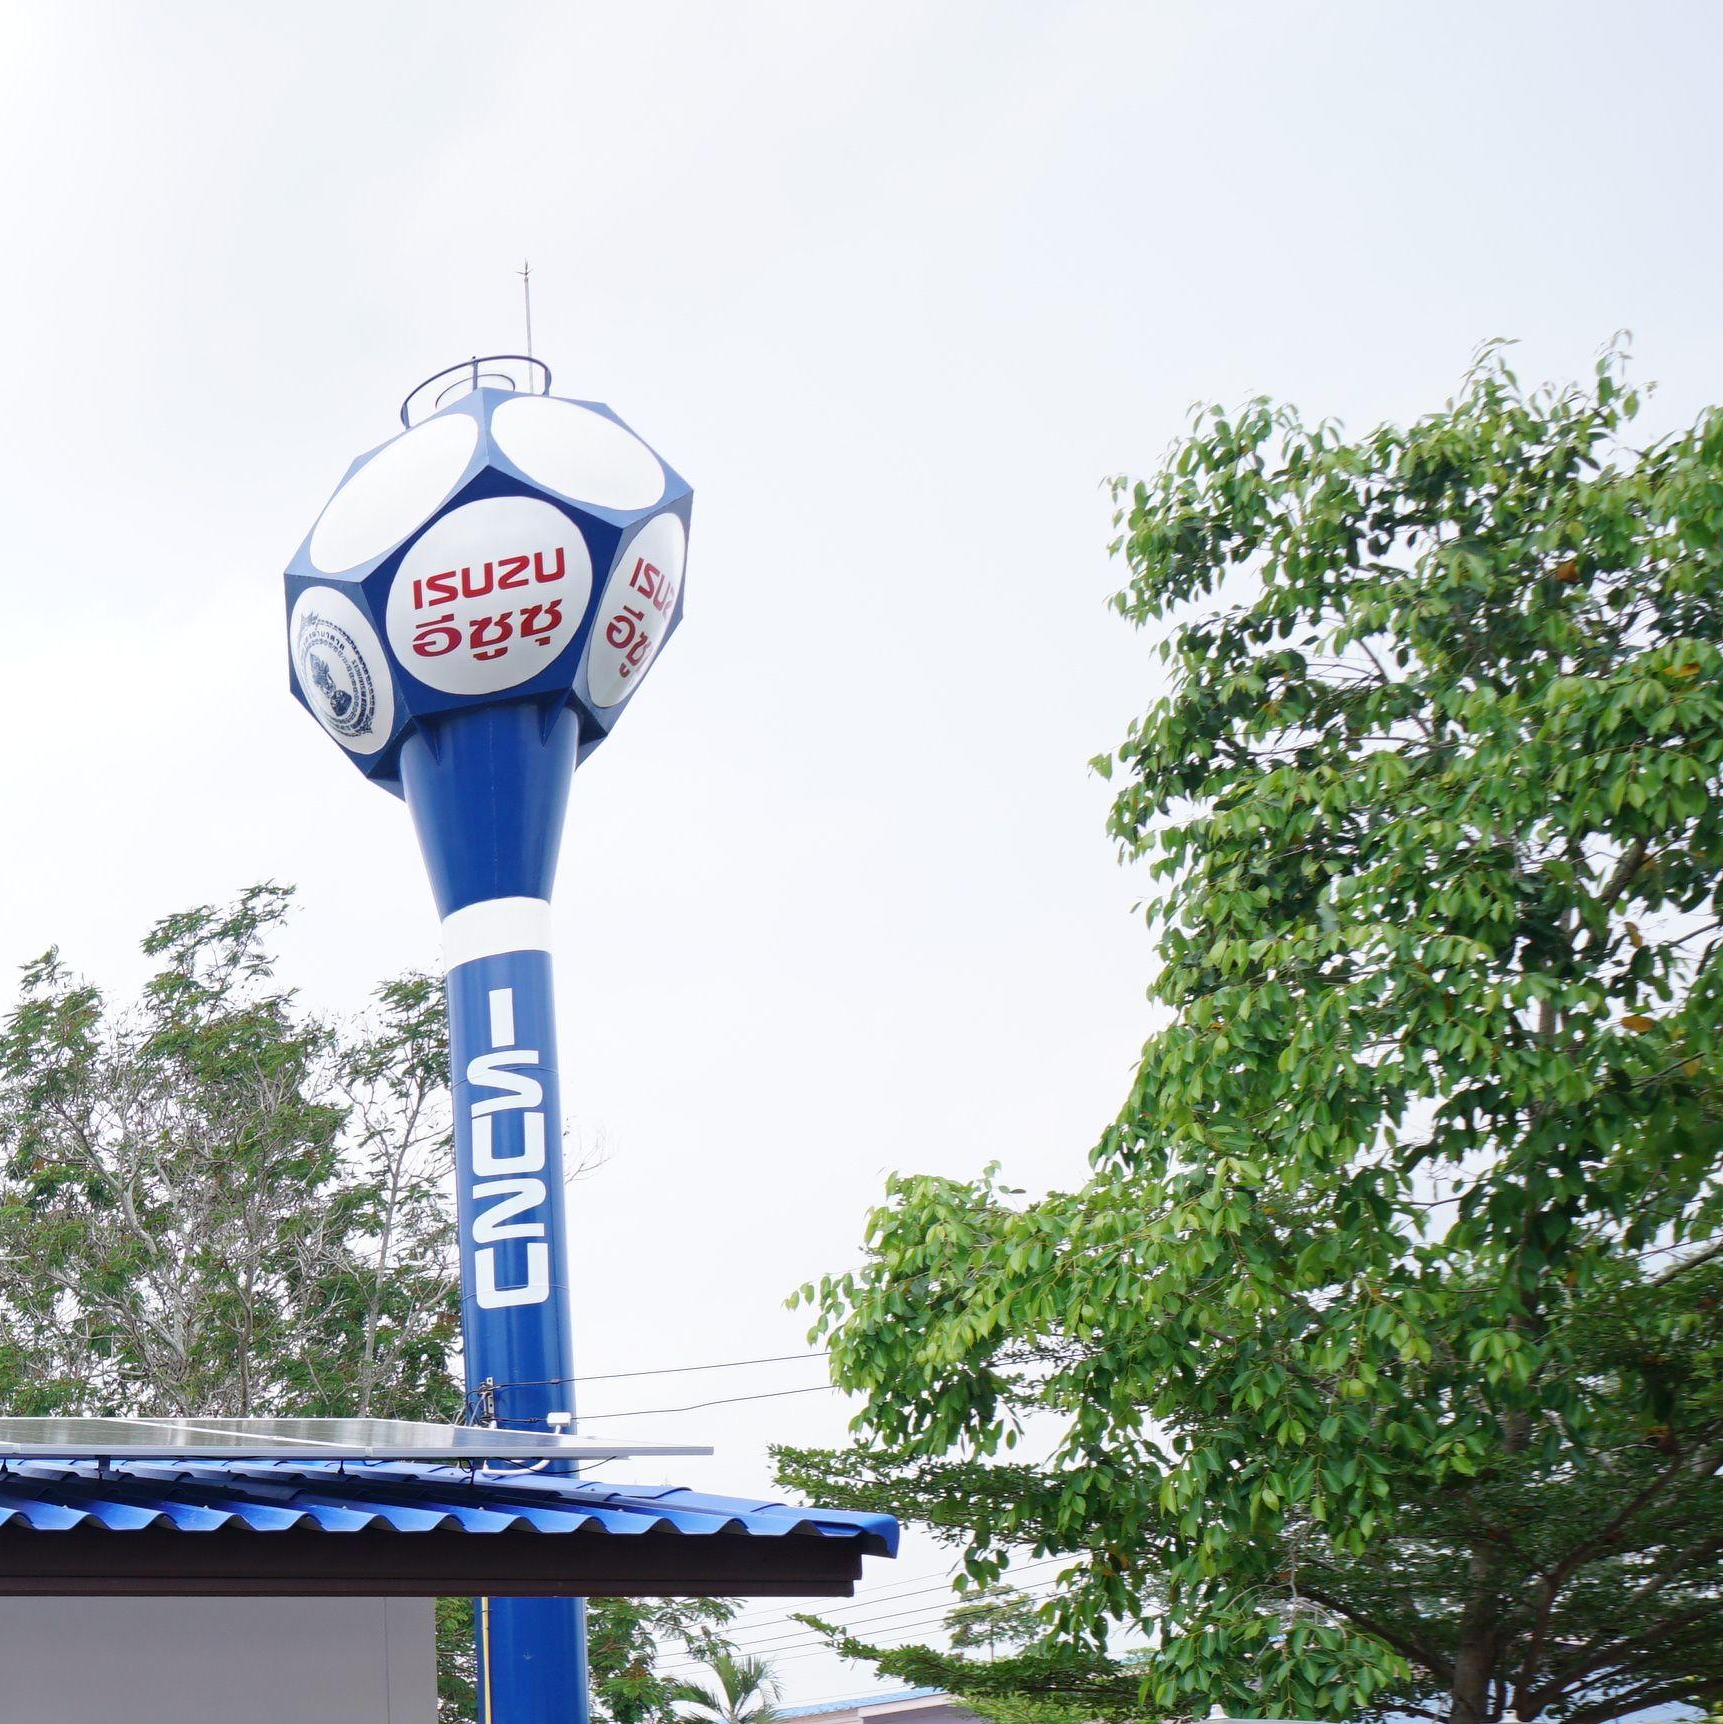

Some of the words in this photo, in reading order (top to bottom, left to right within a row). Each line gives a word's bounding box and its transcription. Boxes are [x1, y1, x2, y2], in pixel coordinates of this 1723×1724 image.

[412, 547, 566, 610] ISUZU
[629, 556, 676, 616] ISUZ
[412, 598, 563, 661] อีซูซุ
[606, 604, 654, 678] อีซู
[466, 987, 550, 1310] ISUZU
